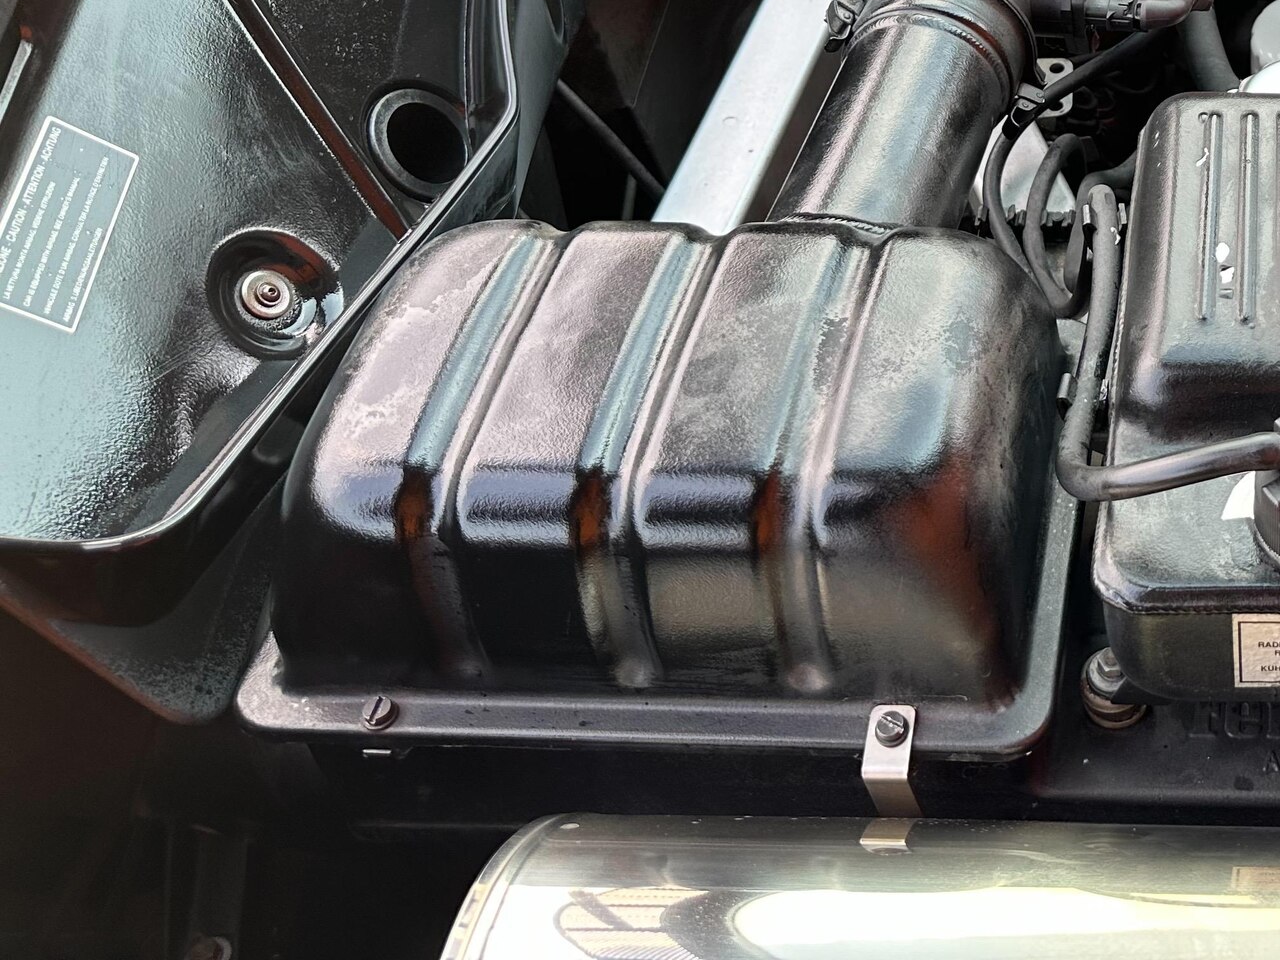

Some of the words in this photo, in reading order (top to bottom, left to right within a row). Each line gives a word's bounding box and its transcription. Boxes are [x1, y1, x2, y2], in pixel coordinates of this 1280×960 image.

[7, 208, 27, 242] CAUTION
[22, 165, 45, 205] ATTENTION
[40, 127, 61, 161] ACHTUNG
